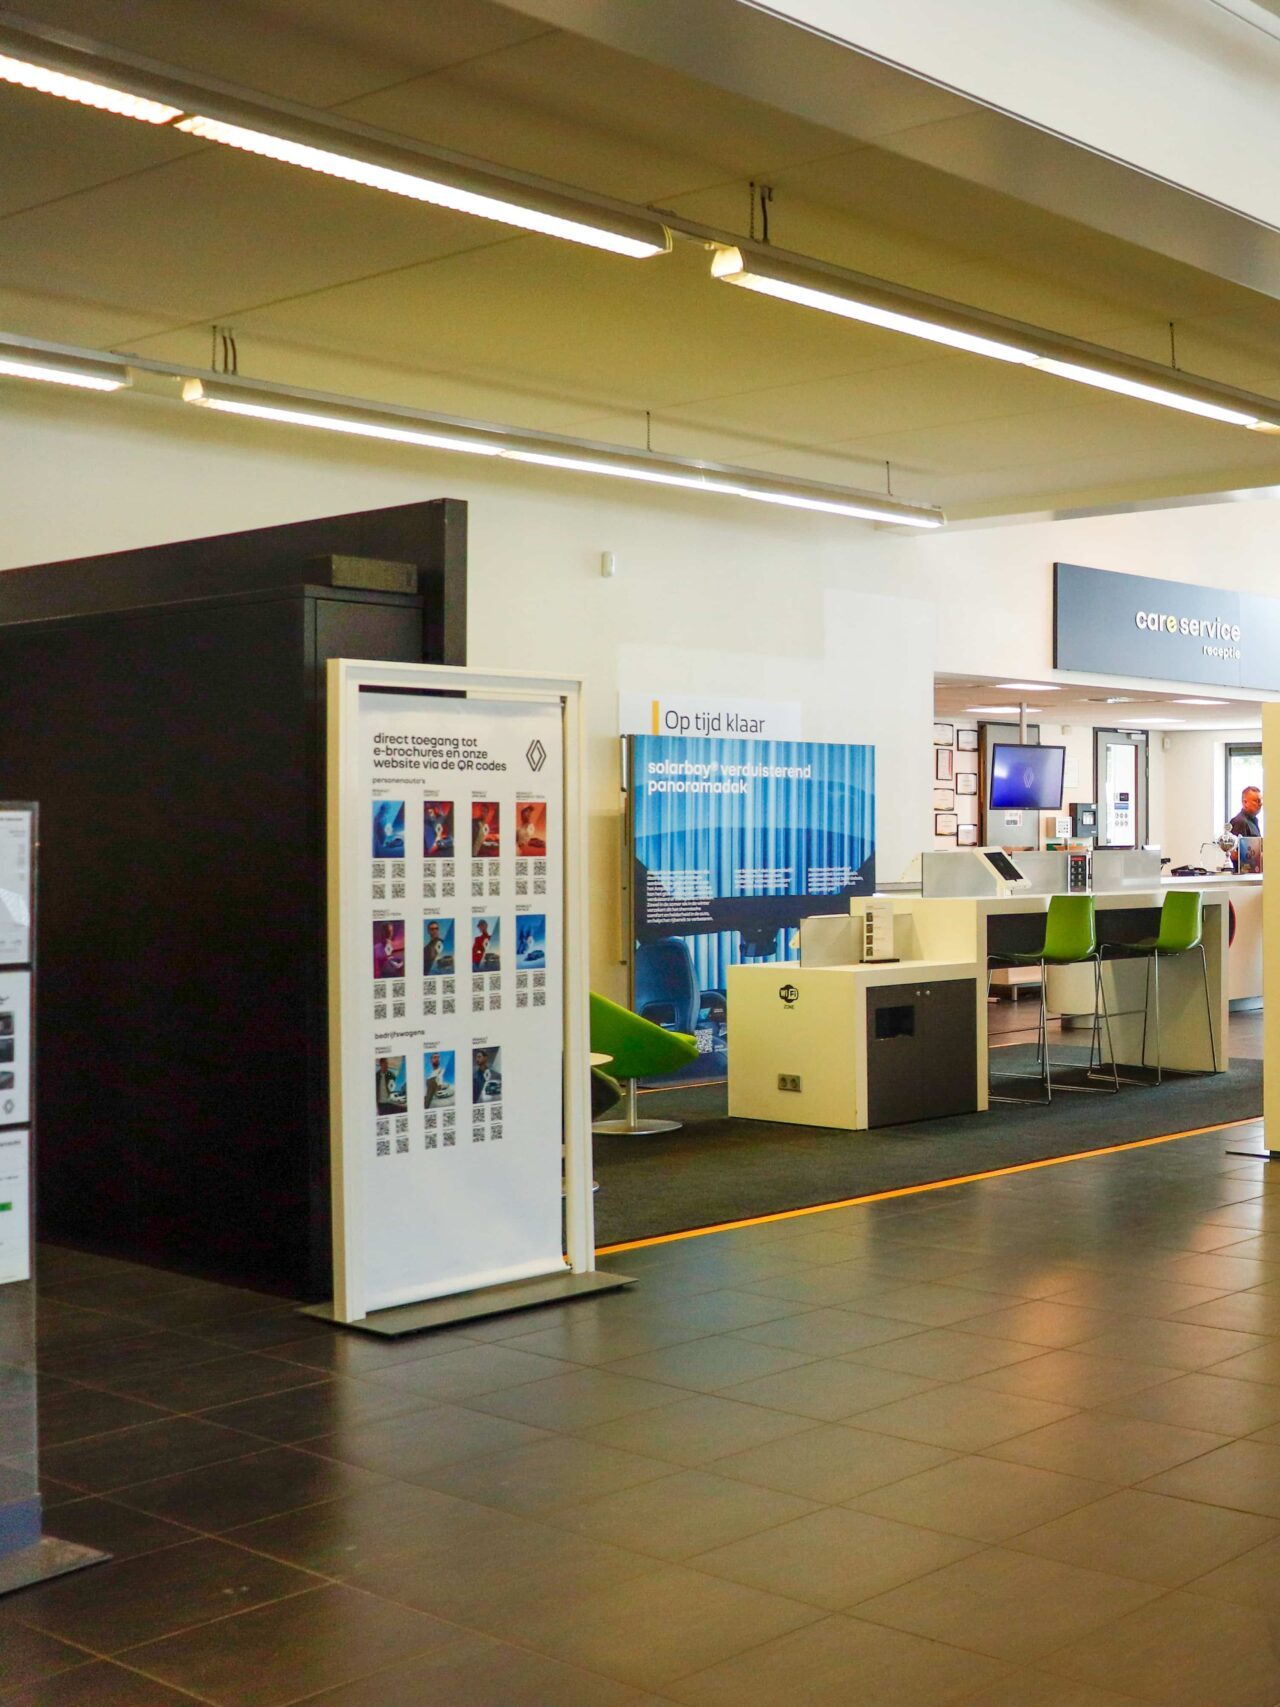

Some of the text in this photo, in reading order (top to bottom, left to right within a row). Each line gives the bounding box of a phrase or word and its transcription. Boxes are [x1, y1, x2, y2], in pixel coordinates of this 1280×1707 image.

[1135, 611, 1240, 641] care service
[1202, 645, 1240, 660] receptie
[665, 710, 765, 736] Op tijd klaar
[373, 733, 478, 749] direct toegang tot
[373, 745, 488, 759] e-brochures en onze
[373, 758, 507, 771] website via de QR codes
[720, 761, 812, 778] verduisterend
[647, 779, 748, 796] panoramadak
